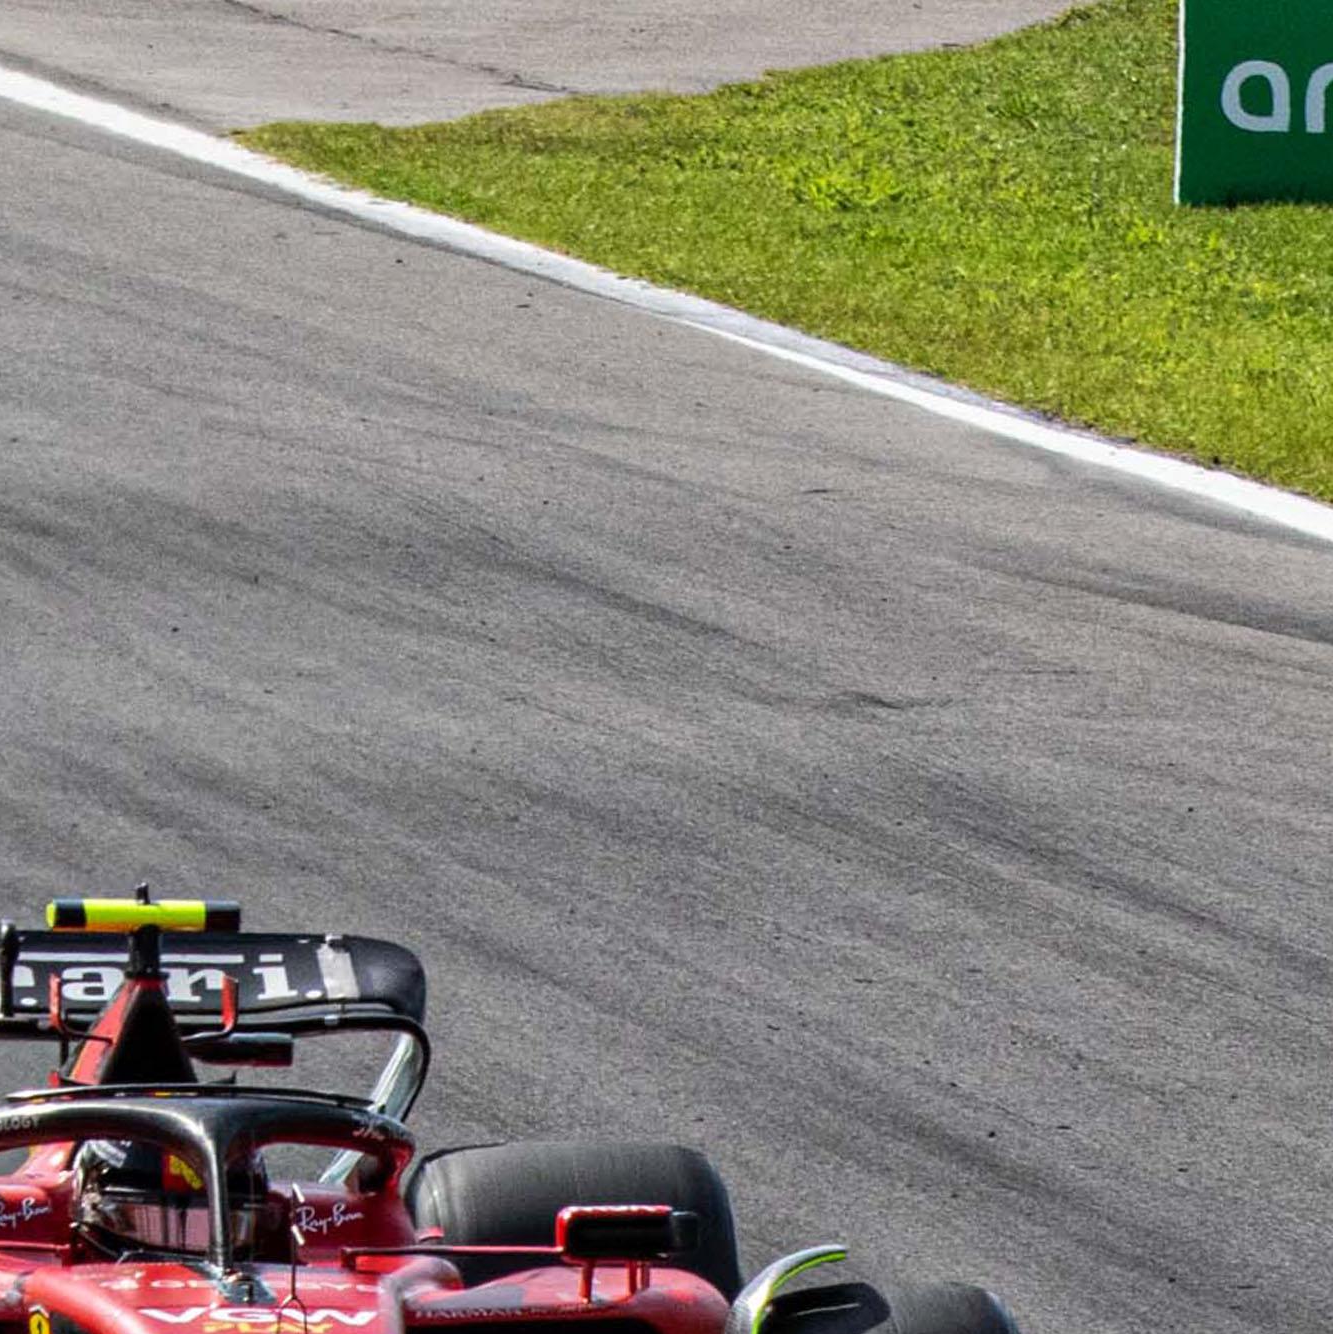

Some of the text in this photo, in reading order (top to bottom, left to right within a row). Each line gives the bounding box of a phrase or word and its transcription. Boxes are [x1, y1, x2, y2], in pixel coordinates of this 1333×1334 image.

[296, 1202, 364, 1234] Ray-Ban
[139, 1308, 378, 1326] VGW
[202, 1321, 334, 1334] PLAY
